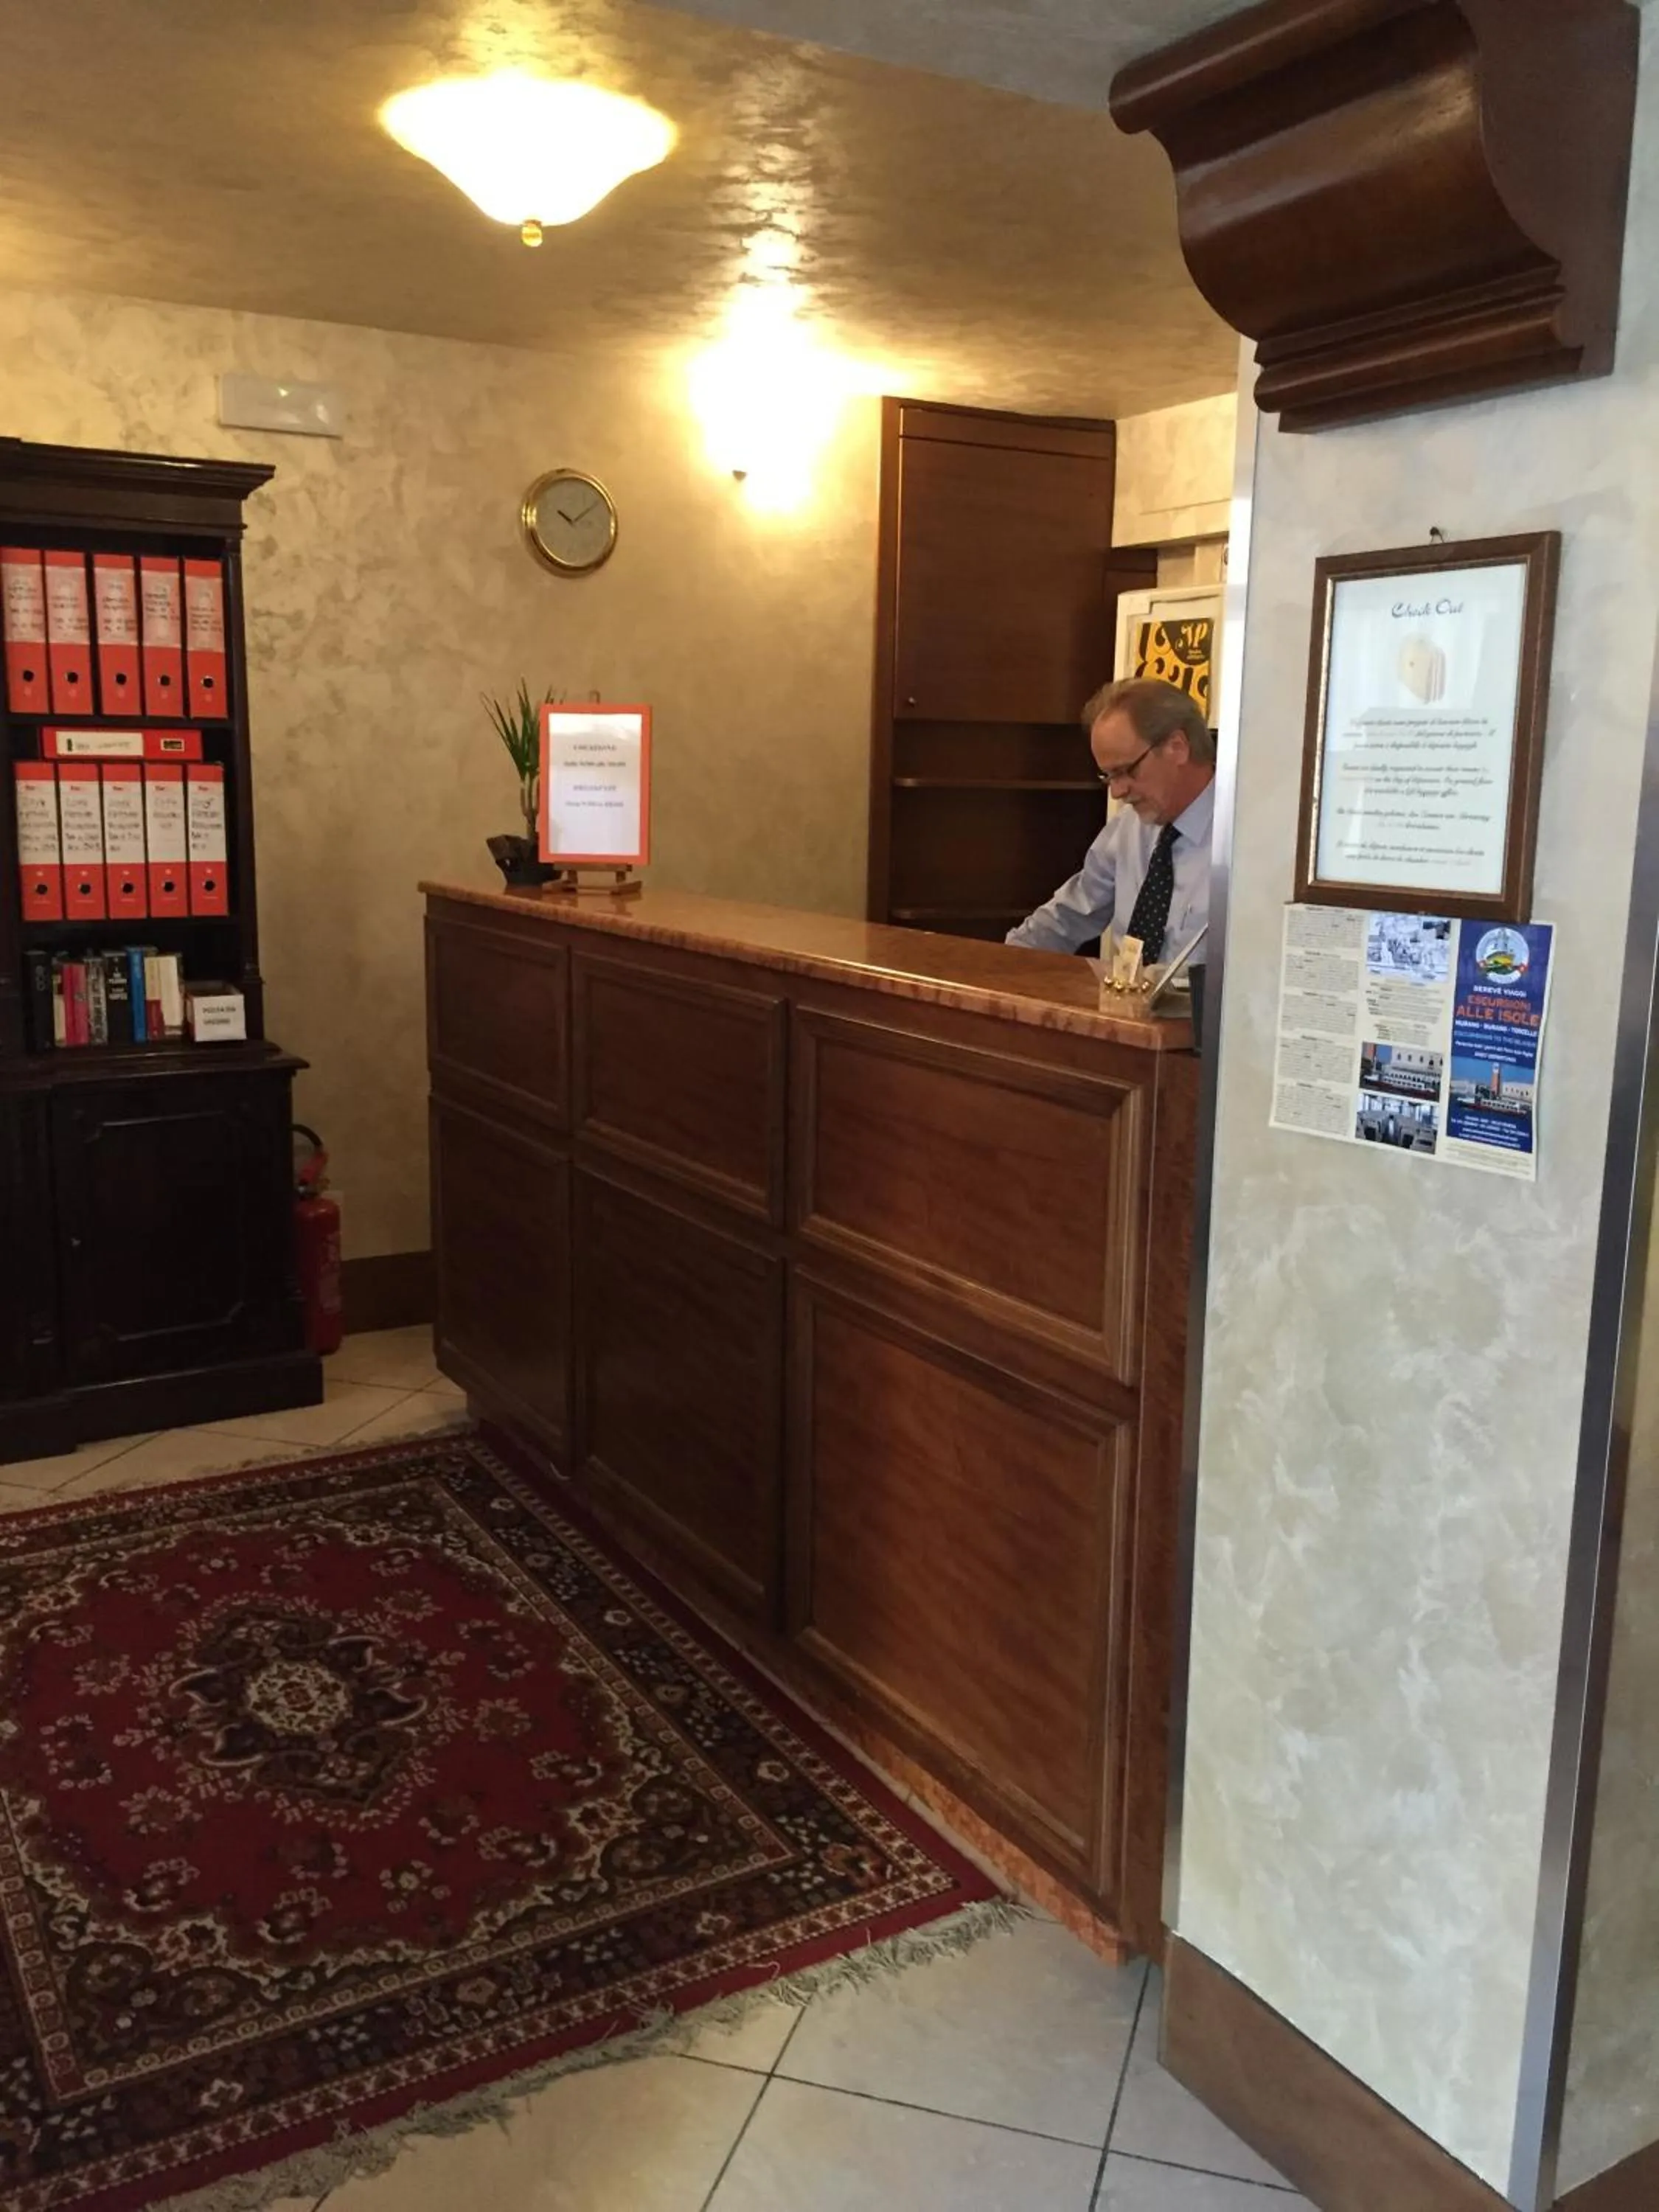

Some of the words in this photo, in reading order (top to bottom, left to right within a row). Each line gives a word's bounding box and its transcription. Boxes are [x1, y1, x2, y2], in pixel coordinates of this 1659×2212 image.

[1391, 601, 1430, 619] Check
[1436, 598, 1464, 614] Out
[1456, 1004, 1494, 1020] ALLE
[1498, 1009, 1540, 1027] ISOLE
